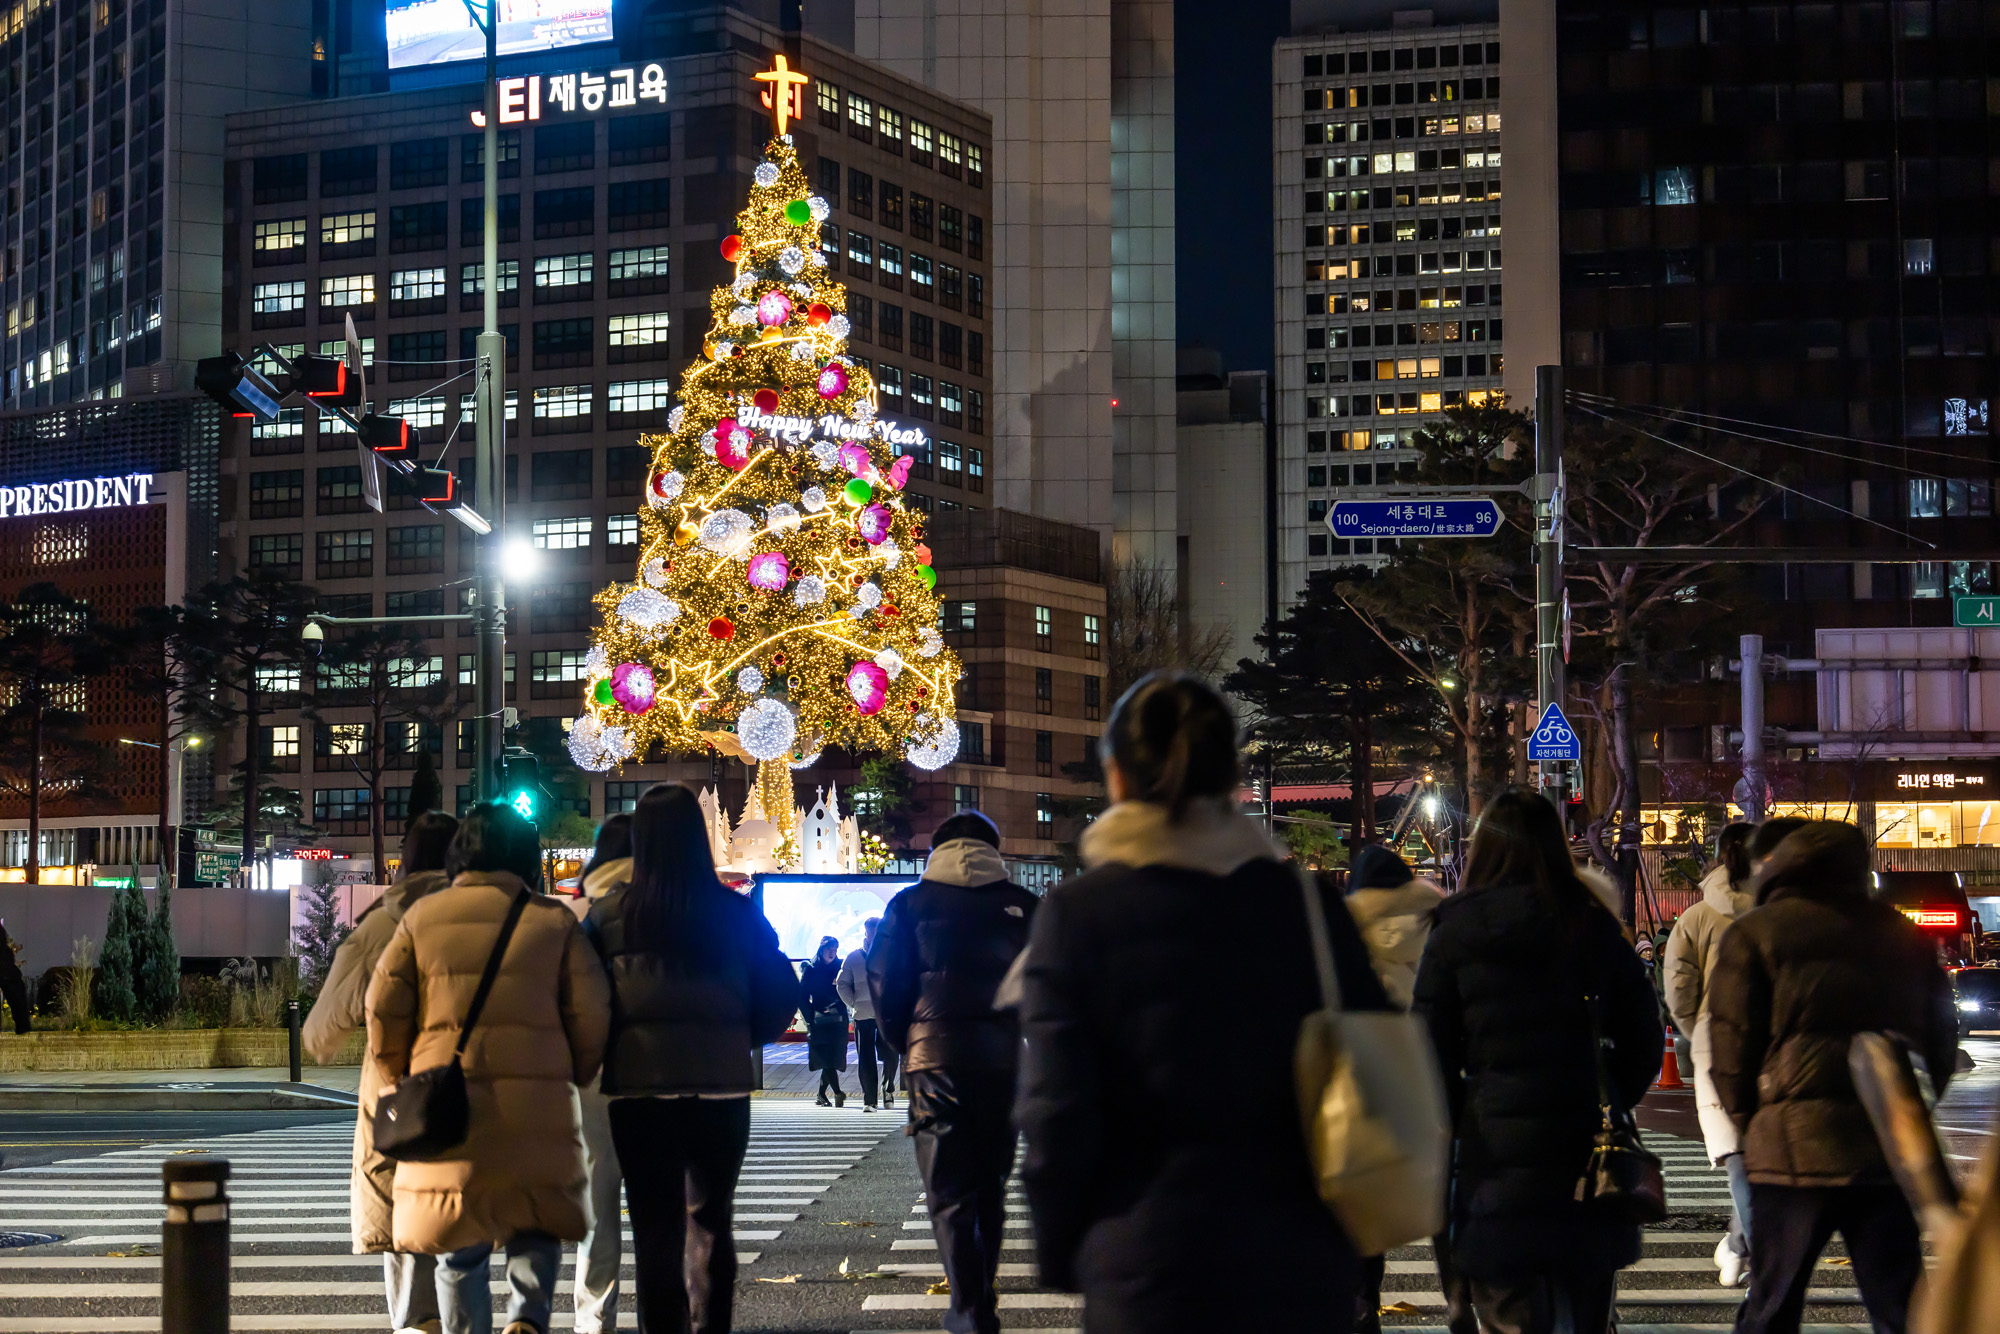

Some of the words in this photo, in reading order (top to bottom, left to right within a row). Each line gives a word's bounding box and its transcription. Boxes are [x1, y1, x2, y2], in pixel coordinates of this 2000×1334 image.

[548, 63, 667, 112] 재능교육
[737, 406, 814, 441] Happy
[819, 414, 873, 439] New
[874, 419, 927, 446] Year
[0, 474, 153, 518] PRESIDENT
[1336, 513, 1359, 526] 100
[1386, 505, 1447, 521] 세종대로
[1475, 511, 1492, 524] 96
[1536, 748, 1571, 758] 자전거횡단
[1897, 774, 1930, 788] 리나인
[1932, 773, 1955, 788] 의원
[293, 849, 332, 860] 구이구이
